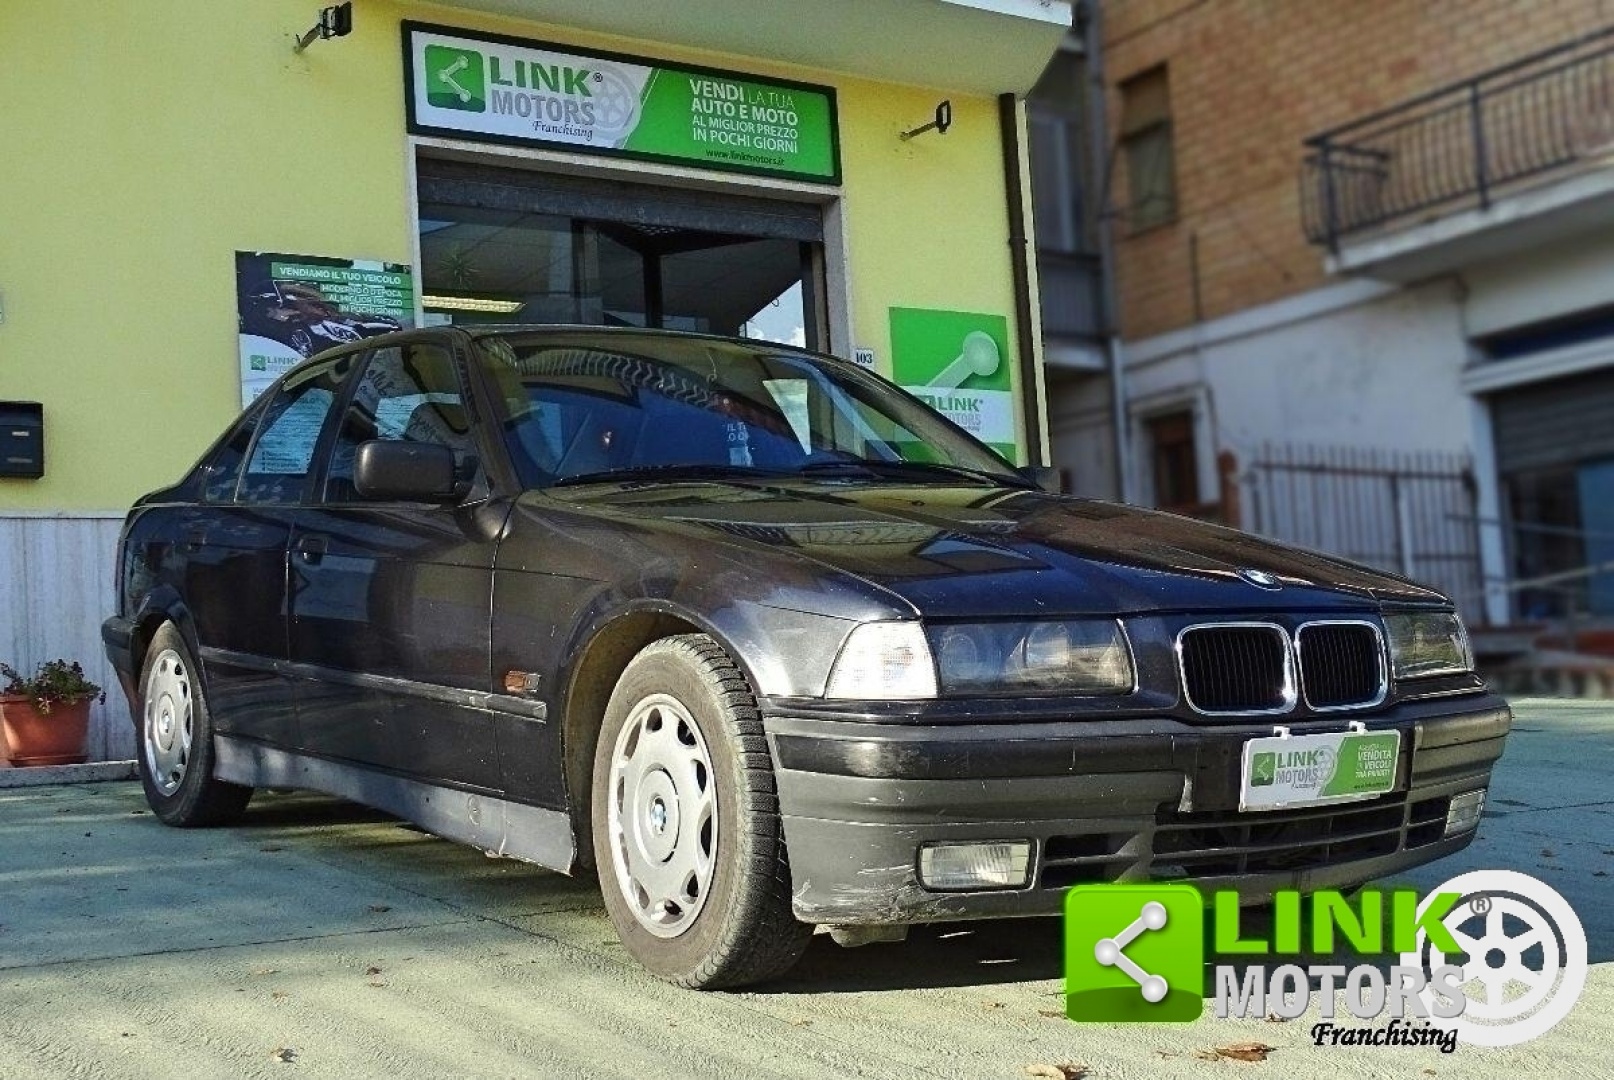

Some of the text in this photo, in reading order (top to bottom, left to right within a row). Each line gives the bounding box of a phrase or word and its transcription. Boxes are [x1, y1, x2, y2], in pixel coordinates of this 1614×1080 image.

[490, 56, 592, 97] LINK
[689, 79, 796, 110] VENDI LA TUA
[491, 89, 596, 126] MOTORS
[691, 98, 798, 126] AUTO E MOTO
[532, 120, 593, 141] Franchising
[692, 115, 798, 139] AL MIGLIOR PREZZO
[693, 127, 798, 153] IN POCHI GIORNI
[705, 149, 785, 165] www.linkmotors.it
[280, 267, 401, 285] VENDIAMO IL TUO VEICOLO
[856, 352, 873, 364] 103
[937, 396, 980, 412] LINK
[1278, 750, 1318, 768] LINK
[1275, 768, 1318, 784] MOTORS
